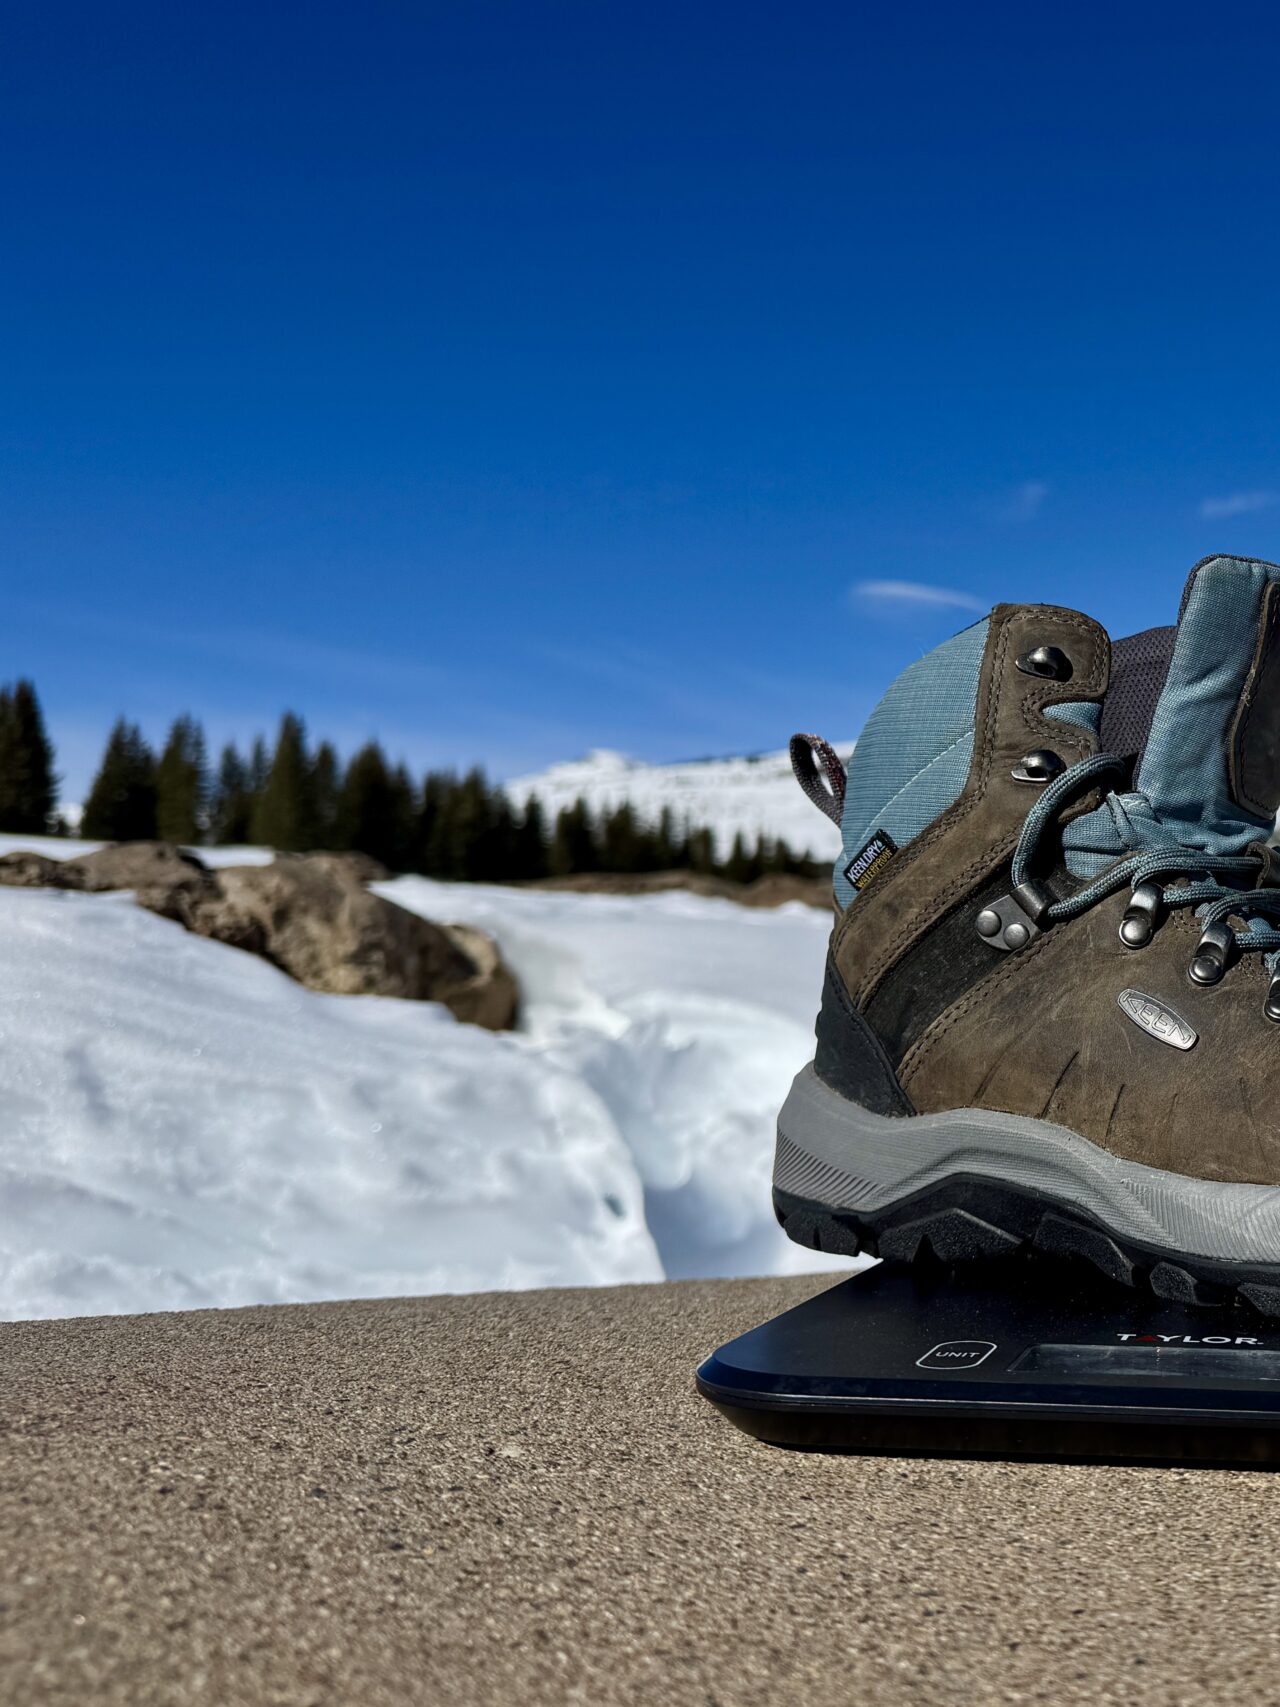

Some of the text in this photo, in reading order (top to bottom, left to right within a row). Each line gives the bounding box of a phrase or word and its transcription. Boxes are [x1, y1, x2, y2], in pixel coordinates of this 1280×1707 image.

[855, 847, 893, 888] WATERPROOF
[1122, 993, 1192, 1044] KEEN
[1116, 1333, 1259, 1345] TAYLOR
